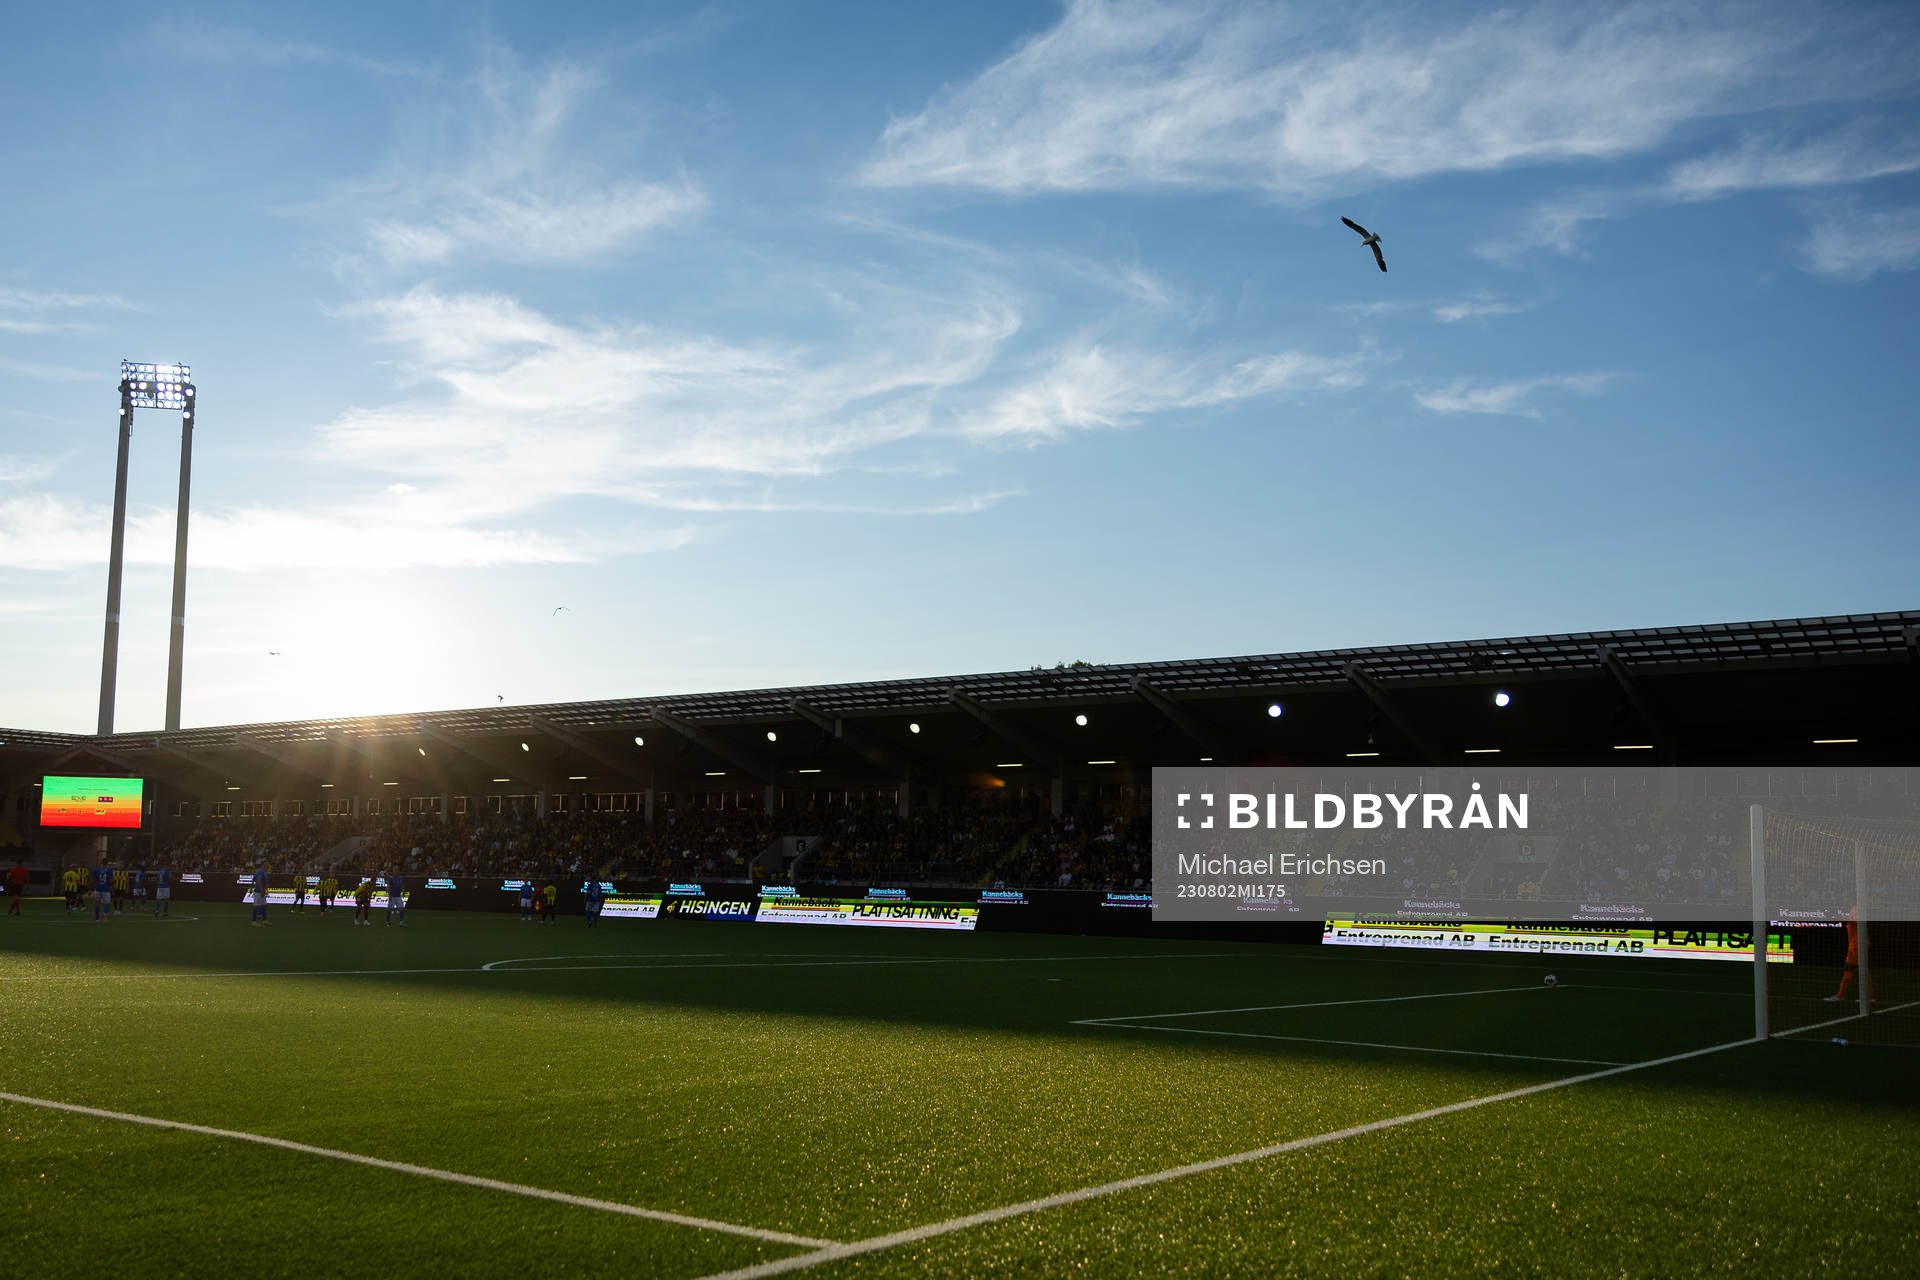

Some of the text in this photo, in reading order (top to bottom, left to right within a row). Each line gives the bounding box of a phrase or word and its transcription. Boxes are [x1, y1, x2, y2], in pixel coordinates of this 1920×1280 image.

[678, 899, 752, 916] HISINGEN
[1336, 930, 1476, 949] Entreprenad AB
[1488, 935, 1645, 954] Entreprenad AB
